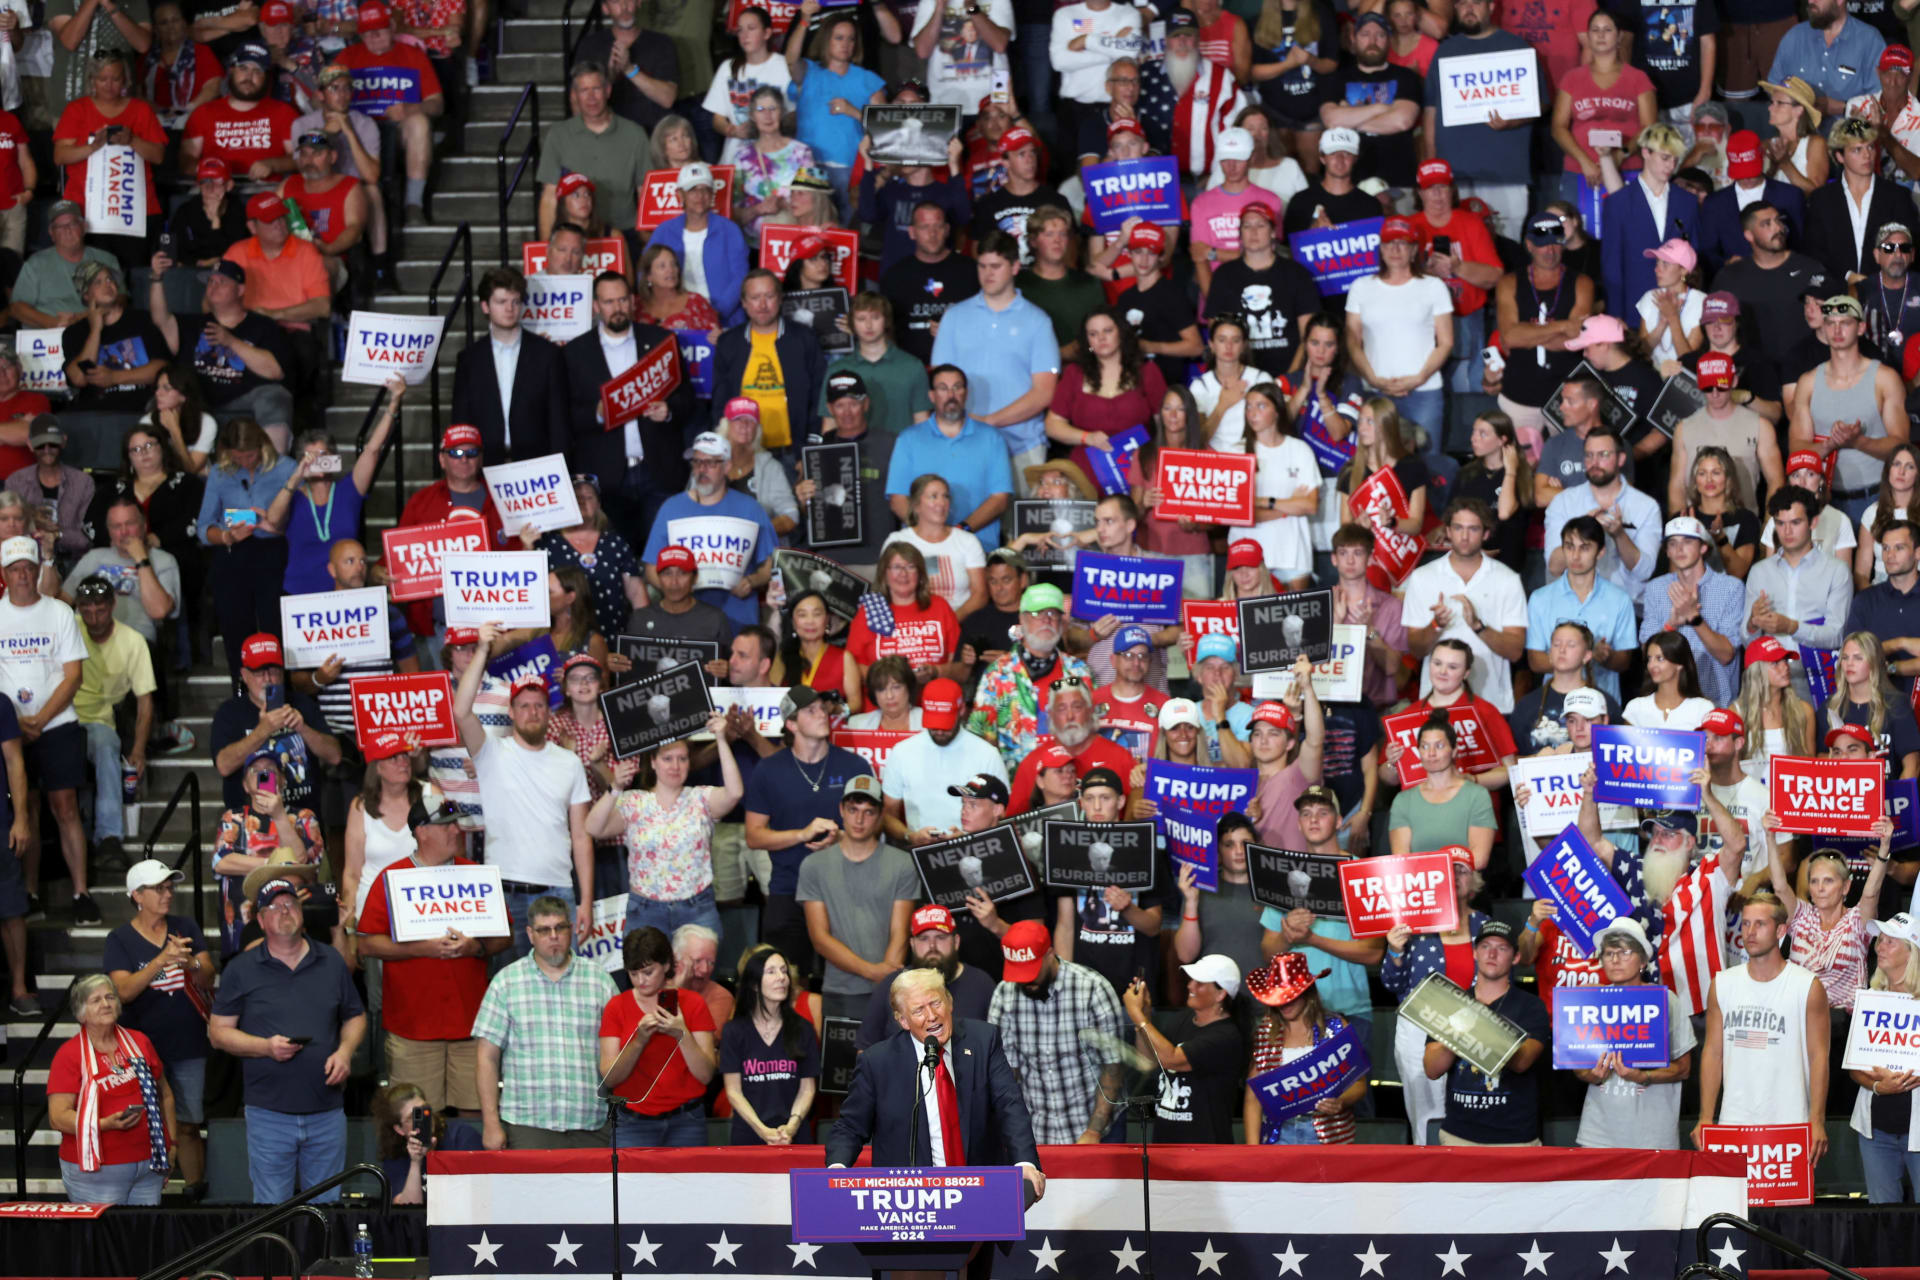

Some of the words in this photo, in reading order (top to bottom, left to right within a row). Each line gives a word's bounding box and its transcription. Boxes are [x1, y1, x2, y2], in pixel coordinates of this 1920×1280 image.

[1450, 67, 1527, 88] TRUMP
[1459, 84, 1521, 101] VANCE
[1574, 97, 1636, 113] DETROIT
[876, 110, 947, 123] NEVER
[215, 126, 272, 138] GENERATION
[215, 135, 272, 149] VOTES
[108, 155, 121, 216] VANCE
[123, 150, 137, 226] TRUMP
[650, 178, 726, 197] TRP
[1091, 171, 1172, 197] TRUMP
[1102, 188, 1165, 208] VANCE
[1300, 233, 1381, 262] TRUMP
[1314, 251, 1377, 273] VANCE
[523, 290, 583, 307] RUMP
[522, 306, 575, 319] ANCE
[360, 330, 435, 350] TRUMP
[367, 347, 426, 364] VANCE
[608, 350, 673, 405] TRUMP
[619, 372, 670, 411] VANCE
[1165, 465, 1248, 487] TRUMP
[494, 473, 560, 499] TRUMP
[839, 456, 855, 529] NEVER
[1173, 483, 1238, 503] VANCE
[503, 491, 558, 513] VANCE
[1026, 508, 1096, 526] NEVER
[393, 535, 482, 563] TRUMP
[676, 534, 752, 553] TRUMP
[405, 559, 443, 577] VAN
[692, 549, 744, 568] ANCE
[451, 571, 537, 588] TRUMP
[789, 556, 857, 590] NEVER
[1083, 567, 1175, 591] TRUMP
[461, 588, 529, 604] VANCE
[1092, 584, 1164, 603] VANCE
[292, 605, 379, 629] TRUMP
[1254, 600, 1321, 625] NEVER
[303, 623, 371, 644] VANCE
[893, 624, 938, 638] RUMP
[1191, 616, 1239, 634] TRU
[0, 637, 51, 650] TRUMP
[11, 647, 39, 656] VANCE
[359, 689, 444, 712] TRUMP
[616, 674, 692, 714] NEVER
[370, 706, 438, 727] VANCE
[619, 711, 711, 750] SURRENDER
[1599, 743, 1695, 766] TRUMP
[1609, 762, 1683, 784] VANCE
[1154, 776, 1247, 802] TRUMP
[1531, 774, 1583, 793] TRU
[1620, 781, 1645, 789] AMERICA
[1779, 773, 1876, 795] TRUMP
[1544, 792, 1584, 808] VAN
[1635, 797, 1654, 806] 2024
[1789, 794, 1865, 812] VANCE
[1801, 811, 1827, 819] AMERICA
[1848, 812, 1871, 820] AGAIN!
[1059, 829, 1139, 848] NEVER
[1164, 817, 1213, 848] TRUMP
[1816, 826, 1837, 834] 2024
[928, 837, 1004, 870] NEVER
[1051, 867, 1148, 884] SURRENDER
[1260, 854, 1337, 880] NEVER
[261, 879, 290, 895] TRUMP
[1349, 870, 1445, 898] TRUMP
[1556, 840, 1617, 922] TRUMP
[401, 882, 494, 902] TRUMP
[1360, 890, 1437, 912] VANCE
[1549, 861, 1600, 928] VANCE
[414, 900, 487, 916] VANCE
[1108, 932, 1135, 945] 2024
[1002, 944, 1037, 963] MAGA
[1555, 969, 1601, 988] 2020
[1563, 1004, 1660, 1025] TRUMP
[1723, 1010, 1786, 1034] AMERICA
[1418, 1004, 1492, 1061] NEVER
[1575, 1024, 1650, 1041] VANCE
[1868, 1029, 1920, 1048] VANC
[1874, 1047, 1898, 1055] AMERICA
[743, 1057, 798, 1076] Women
[1263, 1042, 1353, 1097] TRUMP
[1886, 1063, 1904, 1071] 2024
[748, 1074, 765, 1083] FOR
[766, 1072, 791, 1081] TRUMP
[1281, 1060, 1351, 1104] VANCE
[1482, 1095, 1507, 1105] 2024
[1748, 1163, 1793, 1180] NCE
[833, 1177, 861, 1188] TEXT
[865, 1177, 923, 1188] MICHIGAN
[925, 1177, 942, 1187] TO
[945, 1176, 980, 1186] 88022
[1756, 1181, 1776, 1189] GREAT
[1777, 1180, 1799, 1188] AGAIN!
[850, 1189, 963, 1211] TRUMP
[877, 1211, 937, 1224] VANCE
[892, 1231, 925, 1241] 2024
